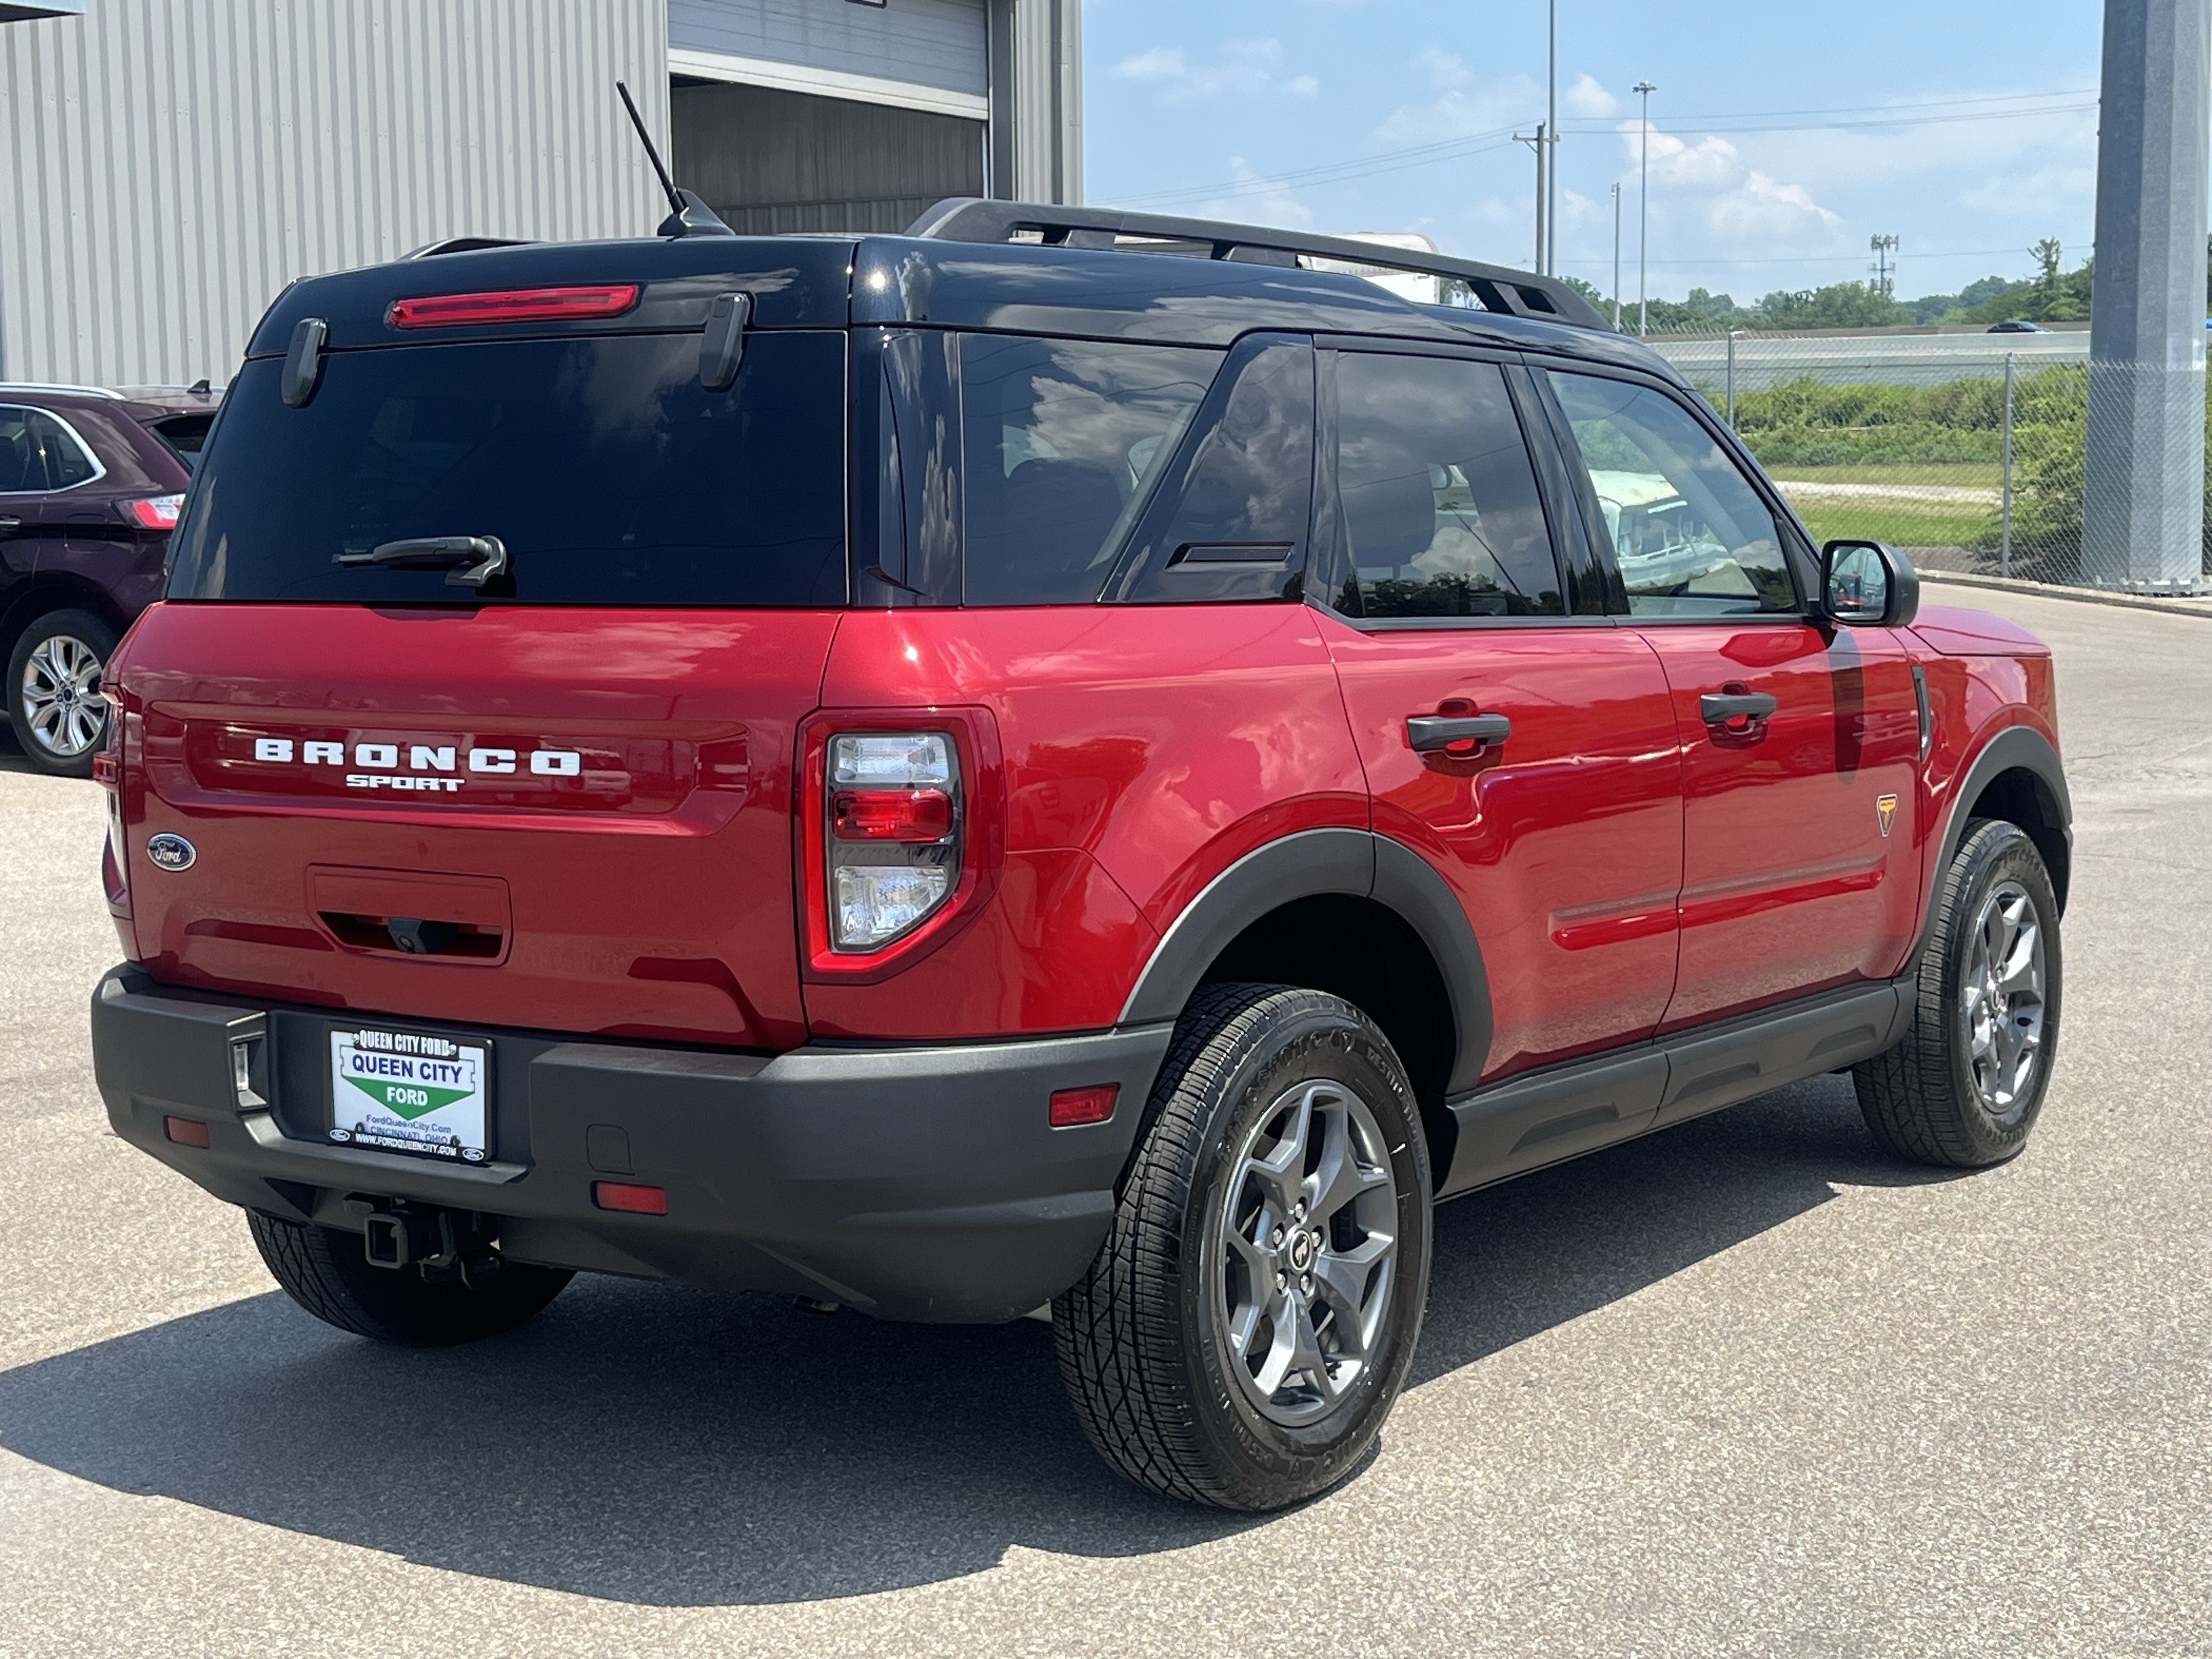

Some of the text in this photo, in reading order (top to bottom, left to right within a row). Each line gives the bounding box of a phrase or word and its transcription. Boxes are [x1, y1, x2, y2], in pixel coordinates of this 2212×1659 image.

[255, 738, 581, 776] BRONCO
[346, 774, 465, 791] SPORT
[359, 1029, 449, 1057] QUEEN CITY FORD
[352, 1054, 462, 1084] QUEEN CITY
[386, 1086, 428, 1107] FORD
[356, 1133, 457, 1156] WWW.FORDQUEENCITY.COM
